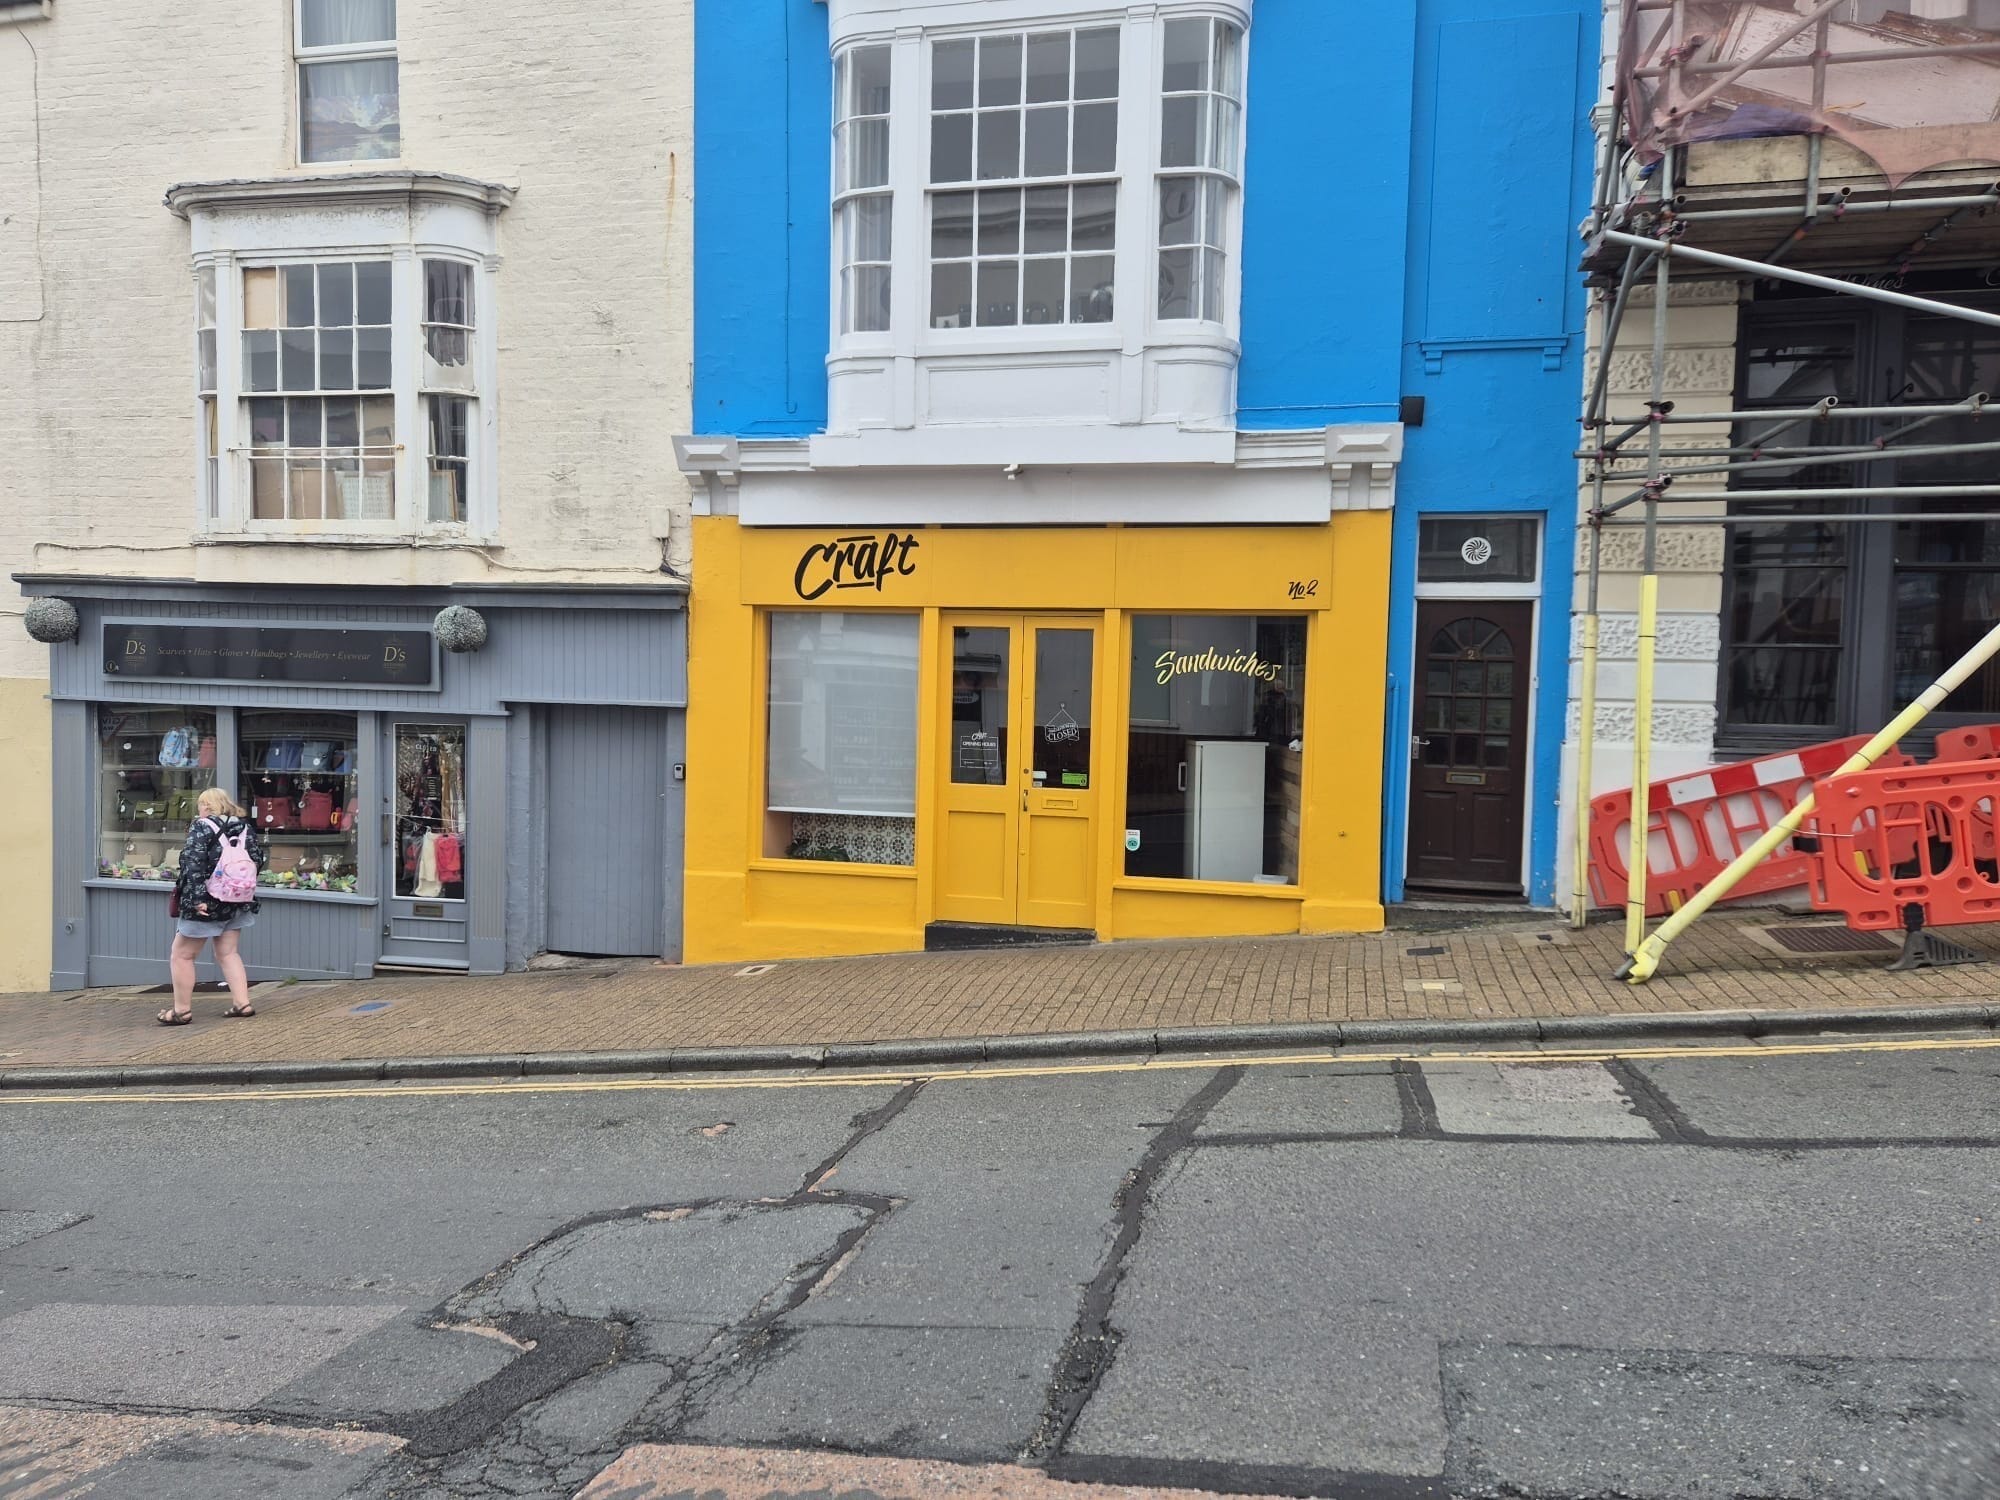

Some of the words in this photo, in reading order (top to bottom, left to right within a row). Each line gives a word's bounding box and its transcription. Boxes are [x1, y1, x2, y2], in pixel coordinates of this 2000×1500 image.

[794, 532, 920, 601] Craft
[125, 639, 147, 655] D's
[156, 647, 186, 656] Scarves
[218, 648, 244, 658] Gloves
[250, 649, 287, 660] Handbags
[293, 650, 331, 660] Jewellery
[383, 646, 407, 662] D's
[1154, 646, 1282, 686] Sandwiches
[1046, 728, 1077, 741] CLOSED
